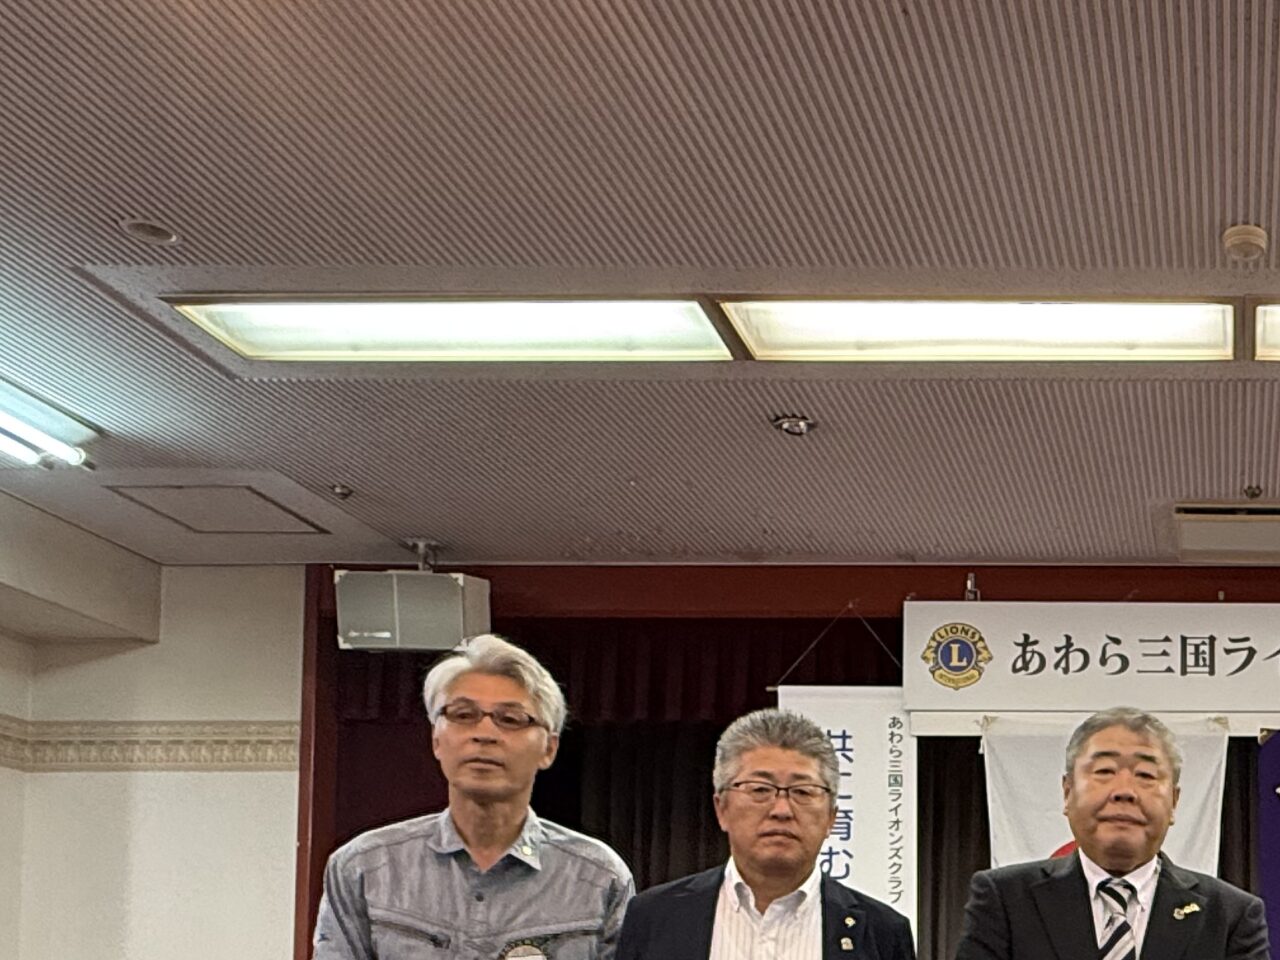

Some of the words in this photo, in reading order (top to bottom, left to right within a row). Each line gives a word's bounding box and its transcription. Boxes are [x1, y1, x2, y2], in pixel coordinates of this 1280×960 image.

[937, 626, 977, 639] LIONS
[949, 643, 968, 667] L
[888, 716, 904, 904] あわら三国ライオンズクラブ
